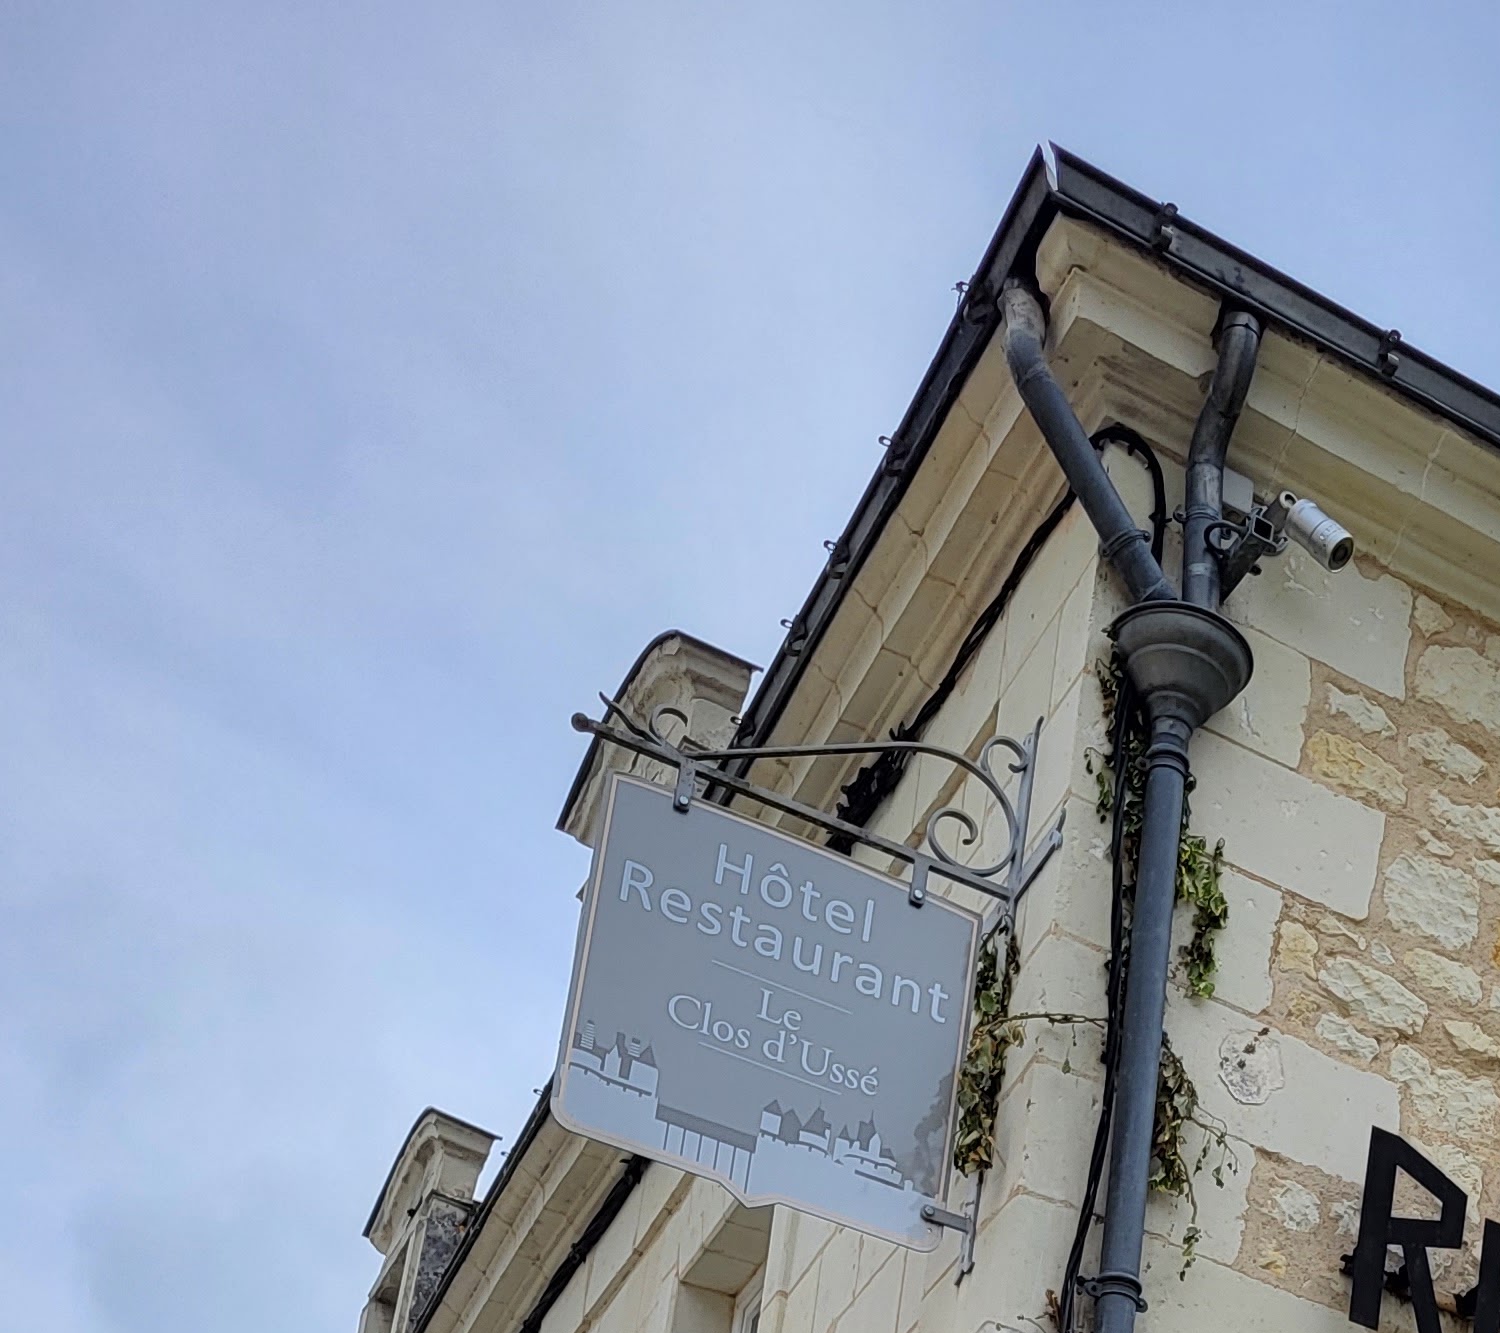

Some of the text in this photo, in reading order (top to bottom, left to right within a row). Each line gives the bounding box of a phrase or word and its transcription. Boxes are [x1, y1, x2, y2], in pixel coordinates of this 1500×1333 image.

[619, 859, 949, 1024] Restaurant
[714, 843, 875, 943] Hôtel
[667, 994, 880, 1096] Clos d'Ussé
[756, 987, 803, 1031] Le
